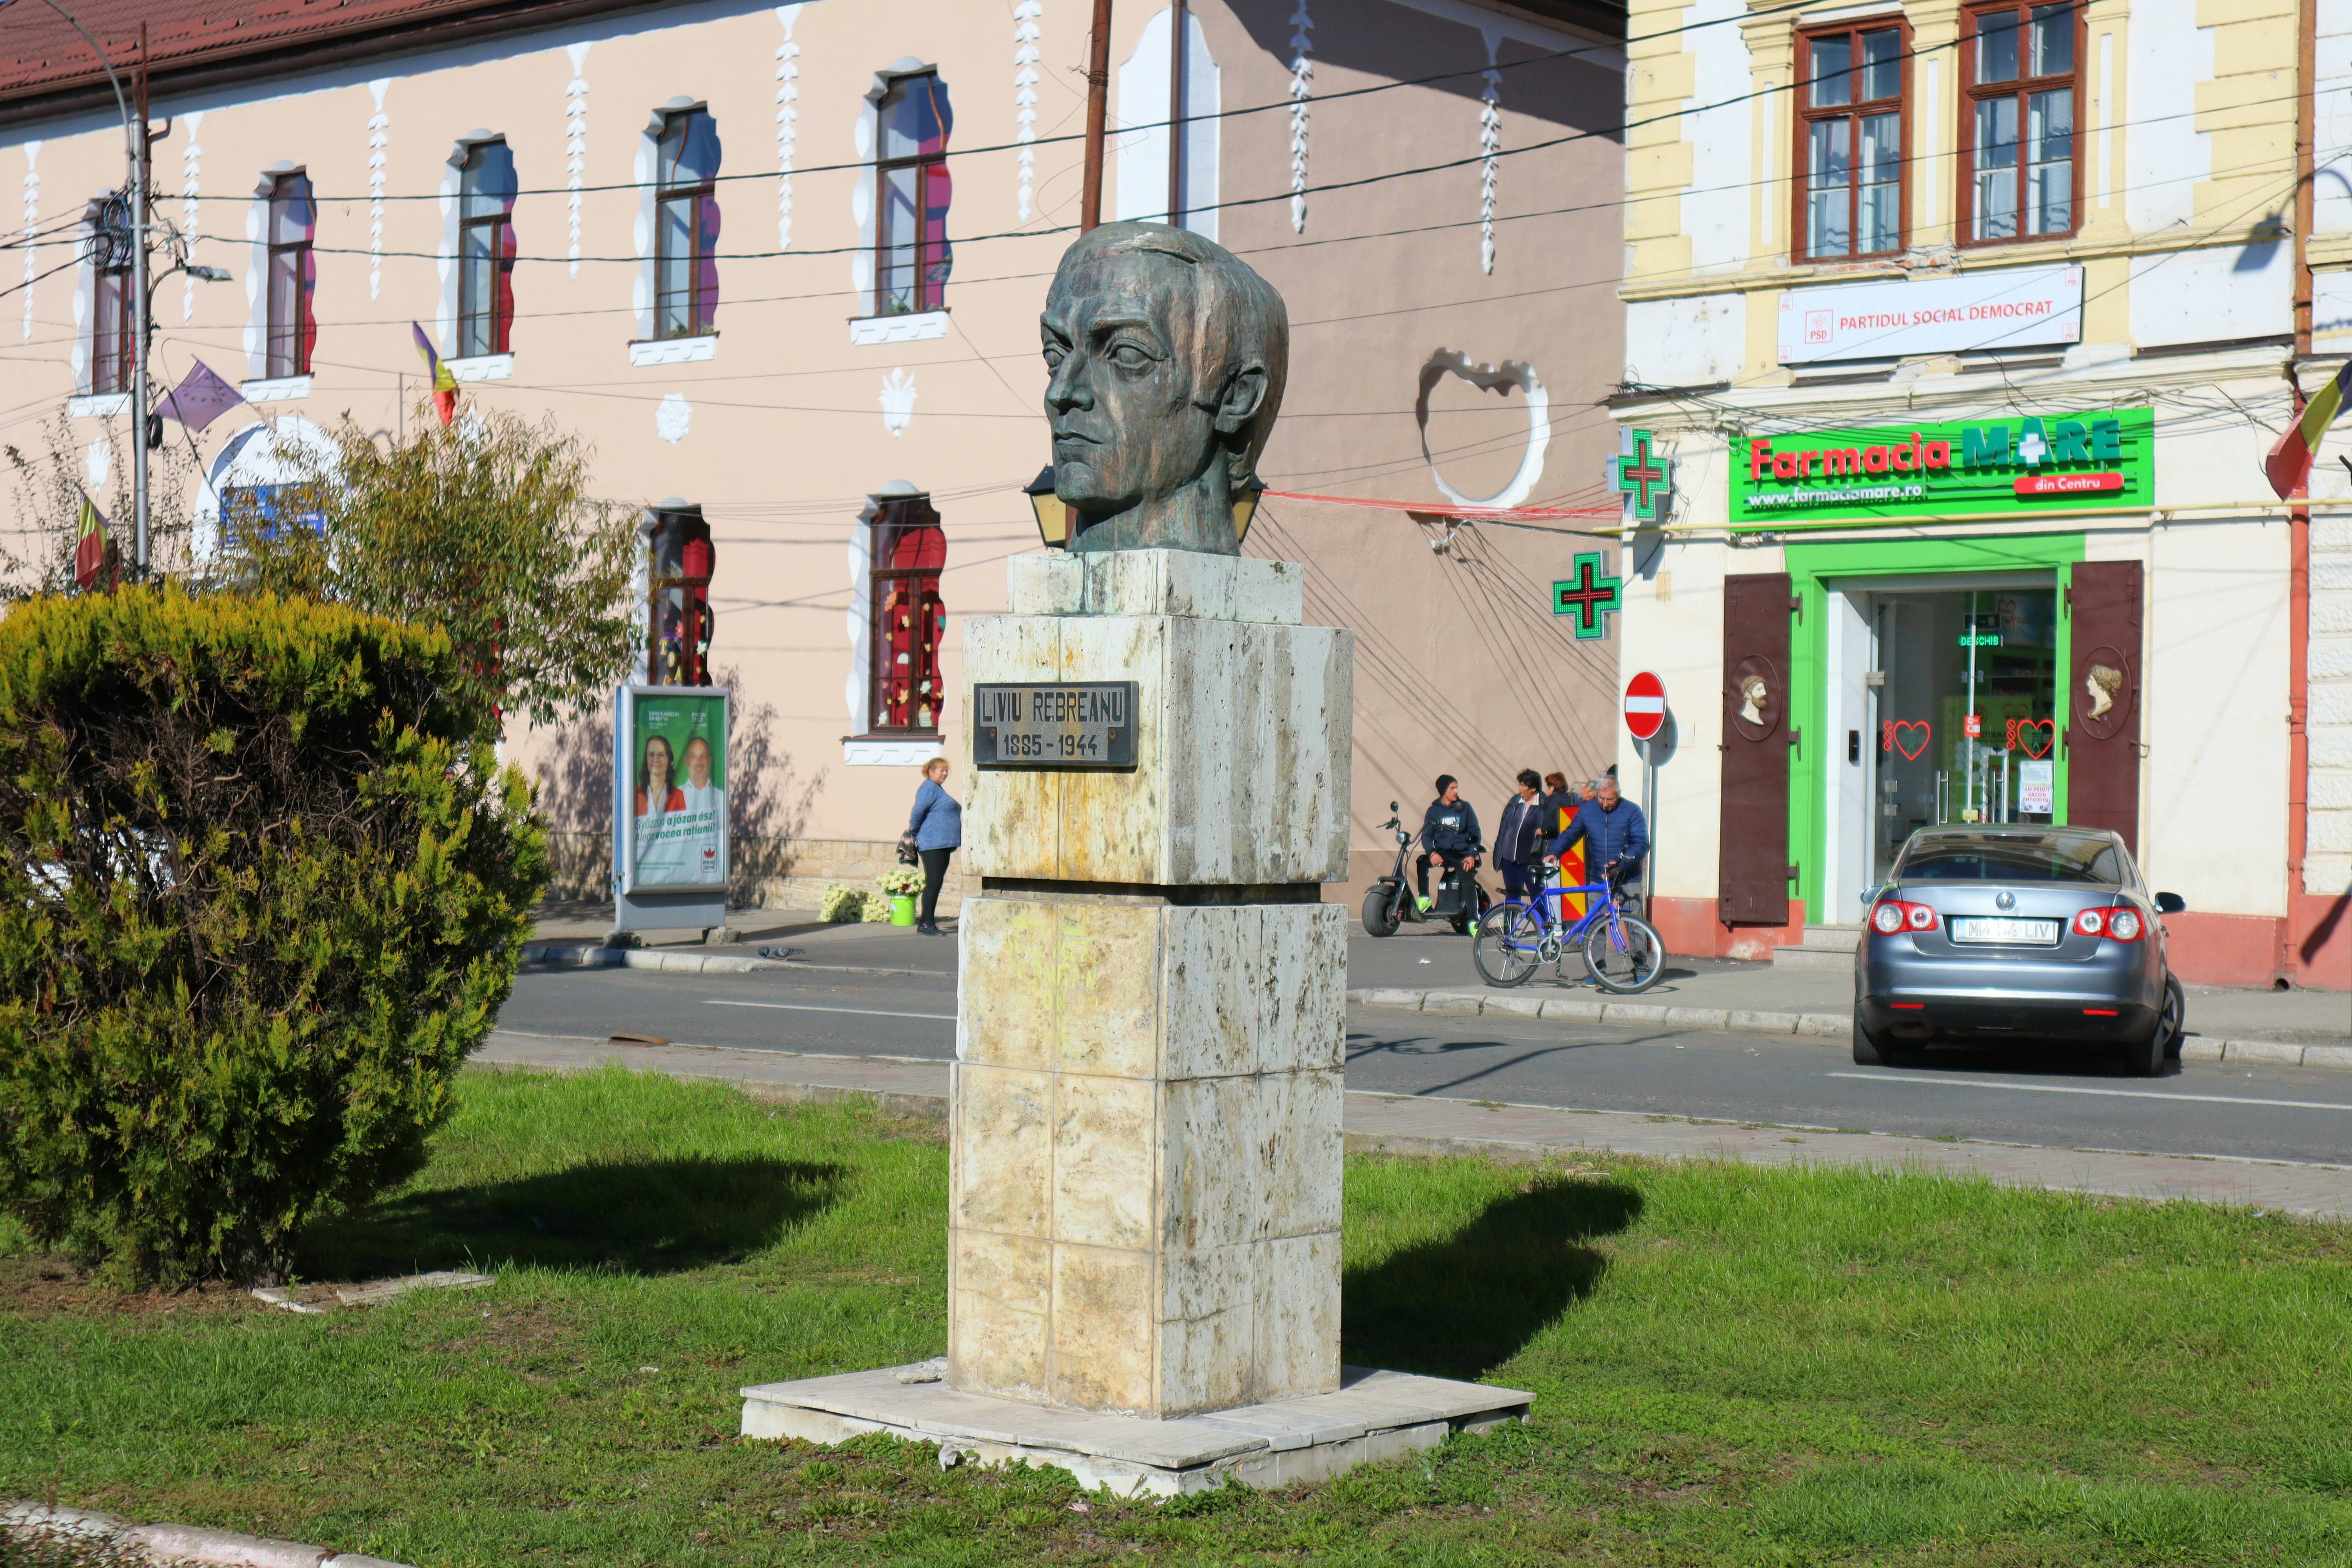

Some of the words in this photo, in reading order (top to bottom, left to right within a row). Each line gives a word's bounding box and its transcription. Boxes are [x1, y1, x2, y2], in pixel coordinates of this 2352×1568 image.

[1840, 312, 1909, 330] PARTIDUL
[1913, 308, 1965, 325] SOCIAL
[1969, 301, 2053, 320] DEMOCRAT
[1811, 330, 1827, 340] PSD
[1750, 432, 1950, 480] Farmacia
[1962, 417, 2120, 468] MARE
[2036, 478, 2056, 491] din
[2058, 476, 2100, 490] Centru
[1749, 484, 1922, 506] www.farmaciamare.ro
[983, 692, 1022, 722] LIVIU
[1033, 691, 1123, 722] REBREANU
[672, 813, 697, 828] józan
[698, 810, 715, 821] ész!
[635, 831, 654, 843] Alege
[655, 828, 681, 839] vocea
[2025, 922, 2049, 938] LIV
